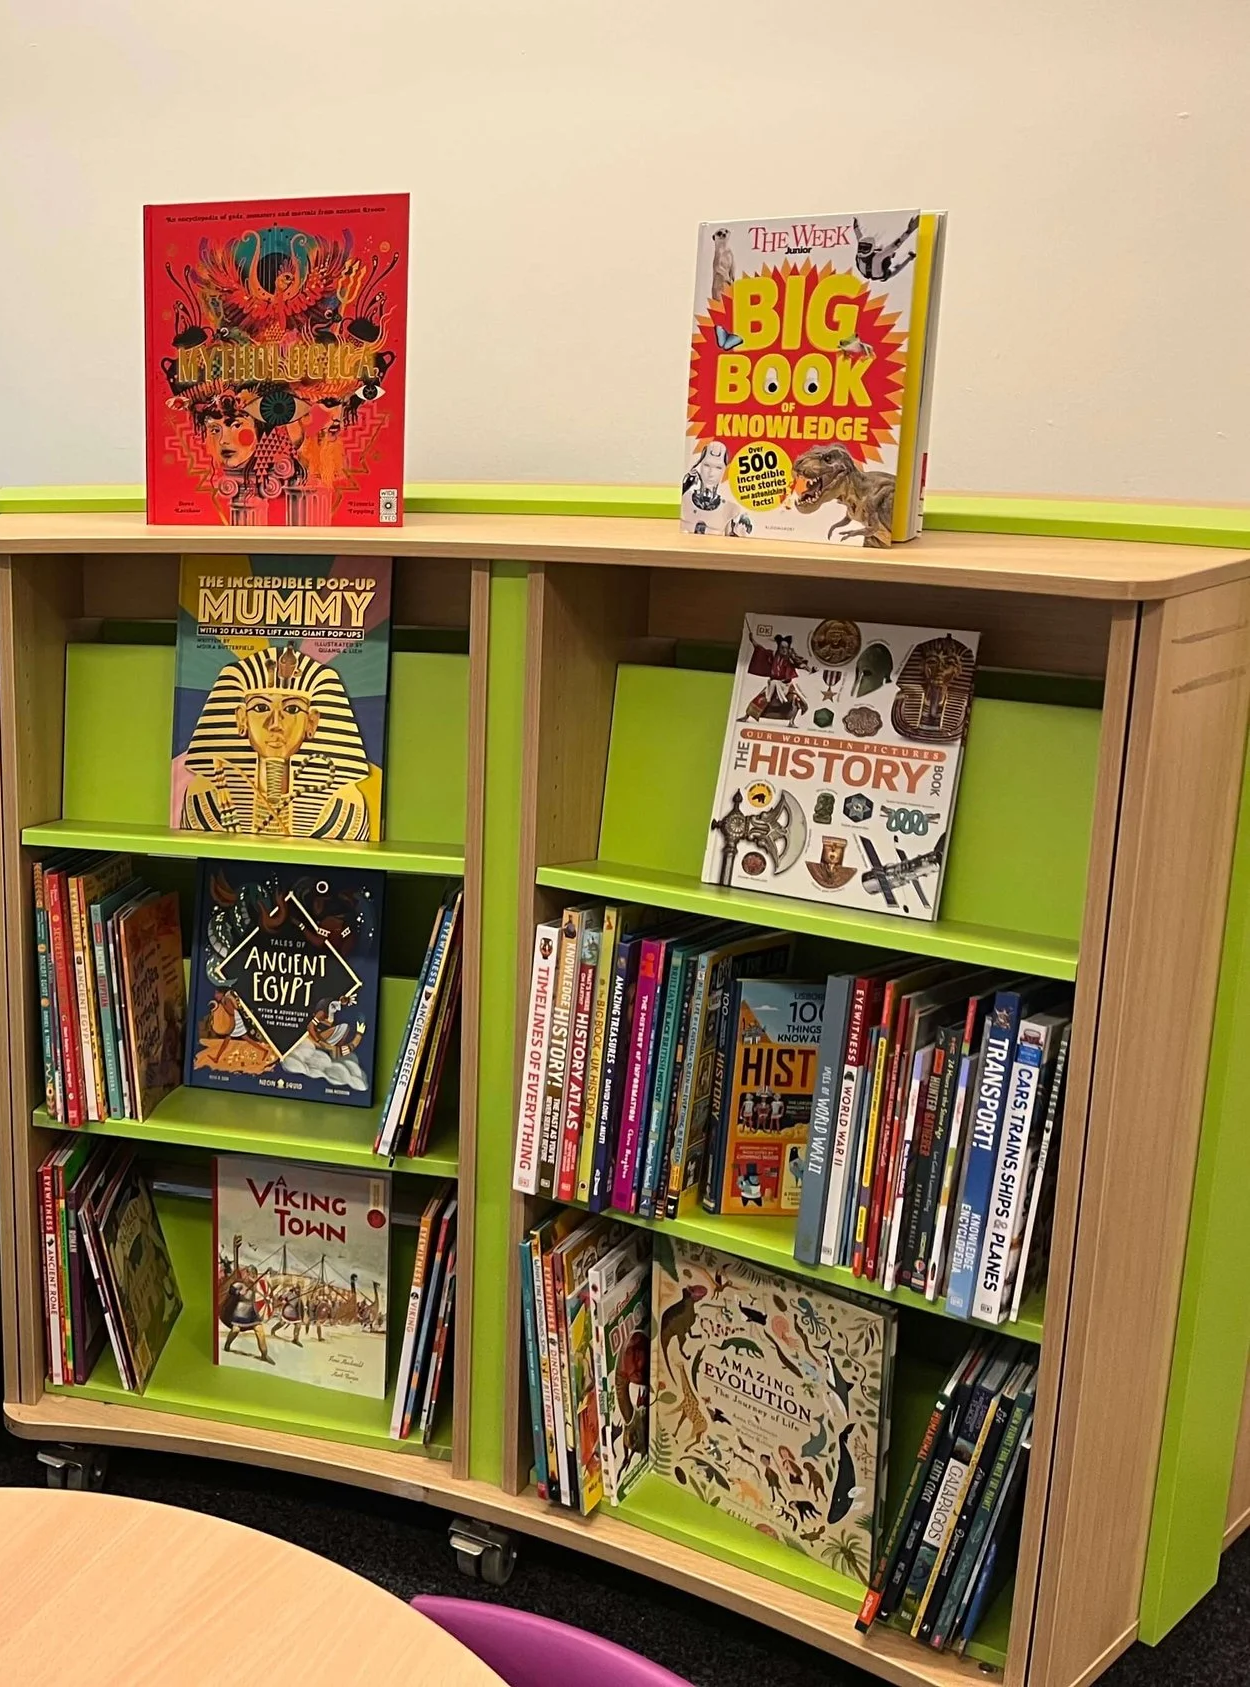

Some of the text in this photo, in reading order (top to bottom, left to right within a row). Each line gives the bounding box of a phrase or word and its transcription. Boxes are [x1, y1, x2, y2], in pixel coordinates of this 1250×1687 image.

[749, 224, 851, 253] THE WEEK
[784, 245, 812, 255] Junior
[734, 273, 864, 352] BIG
[176, 343, 375, 383] MYTHOLOGICA
[715, 353, 872, 406] BOOK
[715, 414, 869, 442] KNOWLEDGE
[781, 402, 795, 413] OF
[737, 469, 785, 484] incredible
[738, 451, 777, 474] 500
[748, 446, 763, 454] Over
[738, 478, 786, 493] true stories
[753, 497, 774, 506] facts!
[198, 576, 376, 590] THE INCREDIBLE POP-UP
[198, 588, 375, 627] MUMMY
[327, 630, 362, 638] POP-UPS
[734, 742, 945, 797] THE HISTORY BOOK
[746, 730, 940, 760] OUR WORLD IN PICTURES
[68, 887, 81, 948] EYEWITNESS
[270, 939, 293, 948] TALES
[244, 946, 327, 977] ANCIENT
[426, 920, 451, 984] EYEWITNESS
[75, 968, 91, 1046] ANCIENT EGYPT
[253, 972, 314, 1006] EGYPT
[547, 942, 576, 1086] KNOWLEDGE HISTORY!
[398, 1002, 428, 1087] ANCIENT GREECE
[606, 975, 624, 1064] AMAZING TREASURES
[653, 965, 679, 1102] BRILLIANT BLACK BRITISH HISTORY
[777, 1034, 807, 1043] KNOW
[847, 988, 864, 1062] EYEWITNESS
[519, 967, 549, 1171] TIMELINES OF EVERYTHING
[565, 1012, 588, 1130] HISTORY ATLAS
[585, 999, 605, 1118] BIG BOOK UK HISTORY
[627, 994, 648, 1121] THE HISTORY OF INFORMATION
[710, 991, 729, 1120] 100 HISTORY
[920, 1075, 940, 1157] HUNTER GATHERER
[971, 1035, 1009, 1150] TRANSPORT!
[806, 1096, 832, 1175] WORLD WAR II
[833, 1085, 853, 1166] WORLD WAR II
[43, 1174, 54, 1231] EYEWITNESS
[246, 1178, 347, 1217] VIKING
[276, 1175, 287, 1188] A
[981, 1067, 1033, 1292] CARS, TRAINS, SHIPS & PLANES
[67, 1229, 77, 1253] ROMAN
[274, 1209, 346, 1244] TOWN
[950, 1203, 972, 1274] ENCYCLOPEDIA
[961, 1212, 981, 1271] KNOWLEDGE
[413, 1226, 427, 1283] EYEWITNESS
[46, 1249, 57, 1315] ANCIENT ROME
[543, 1266, 556, 1330] EYEWITNESS
[405, 1301, 417, 1333] VIKING
[549, 1348, 561, 1402] DINOSAUR
[704, 1362, 811, 1423] EVOLUTION
[720, 1355, 795, 1397] AMAZING
[714, 1385, 799, 1431] The Journey of Life
[916, 1409, 942, 1461] HUMANIMAL
